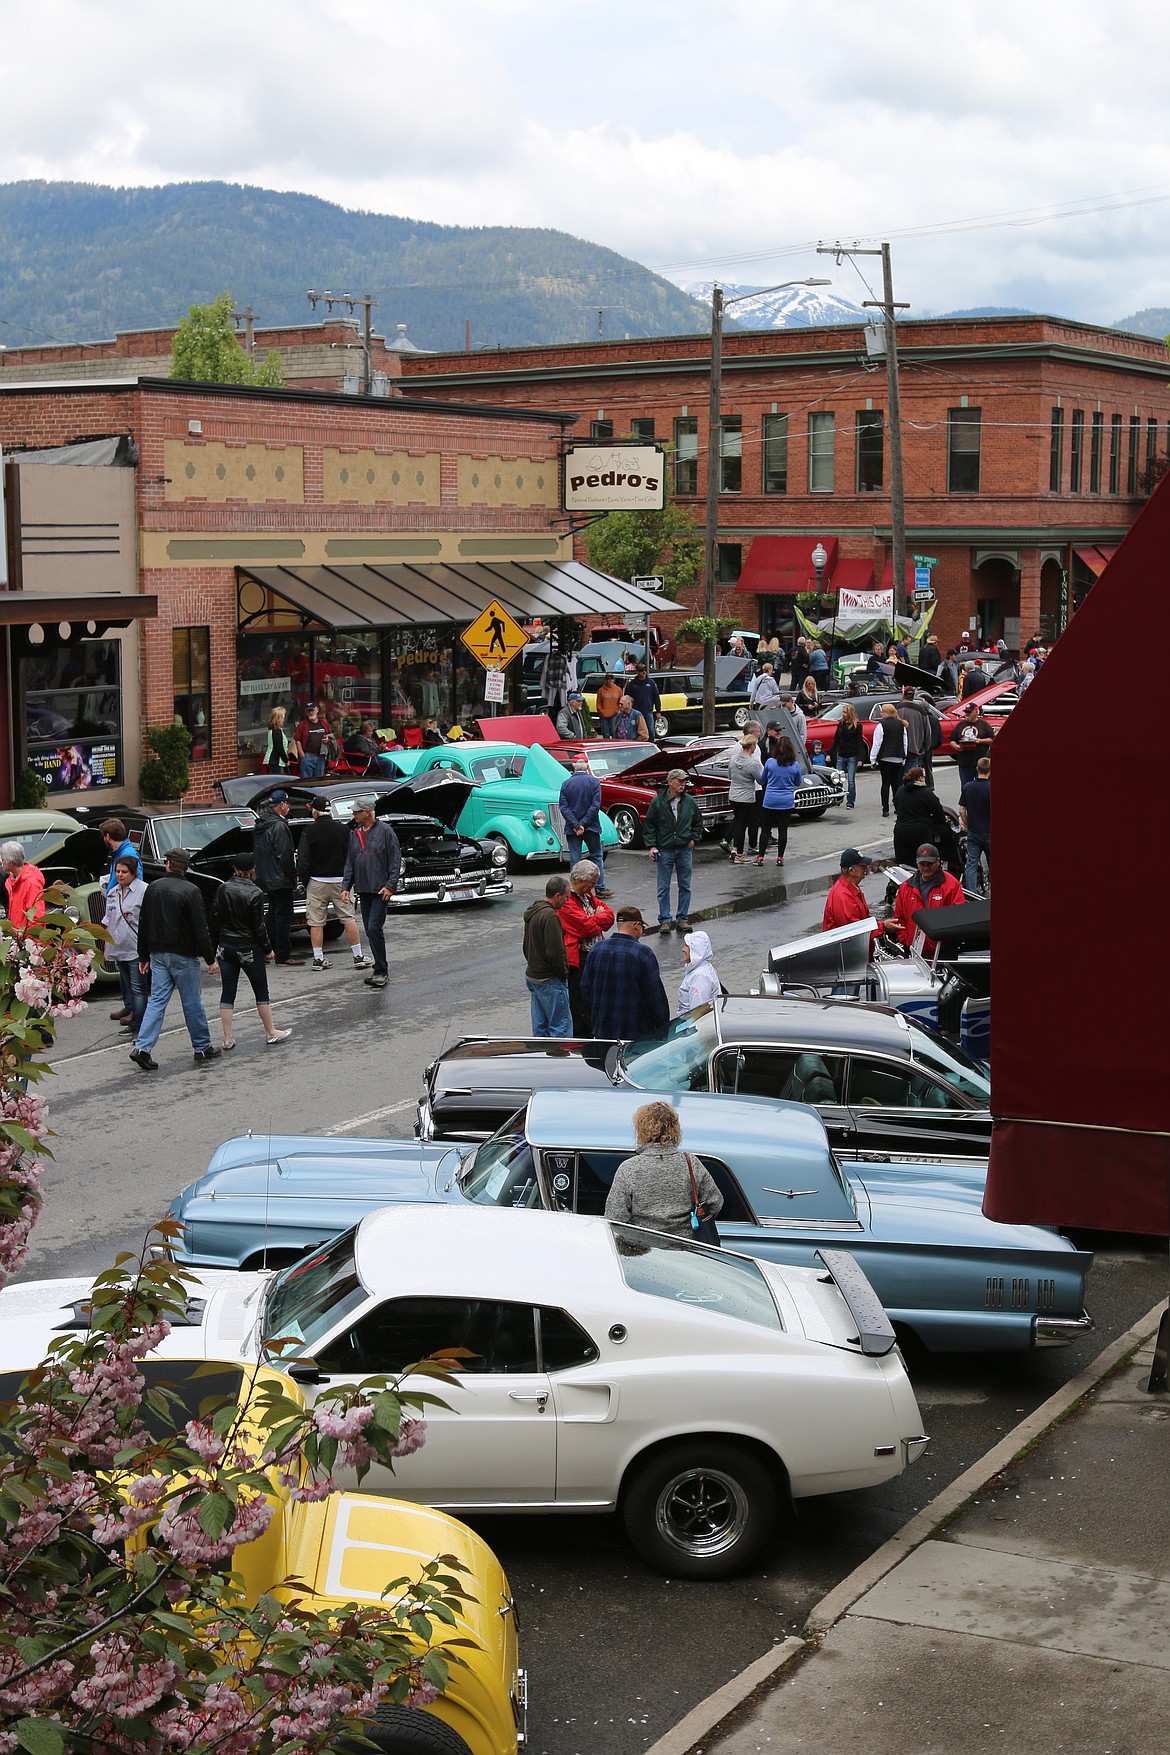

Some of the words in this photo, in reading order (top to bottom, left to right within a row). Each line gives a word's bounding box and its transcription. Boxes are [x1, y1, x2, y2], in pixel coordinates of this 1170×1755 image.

[570, 471, 659, 492] pedro's
[842, 592, 858, 607] WIN
[857, 594, 874, 608] THIS
[874, 594, 892, 608] CAR
[44, 760, 62, 769] BAND
[554, 1157, 569, 1168] W
